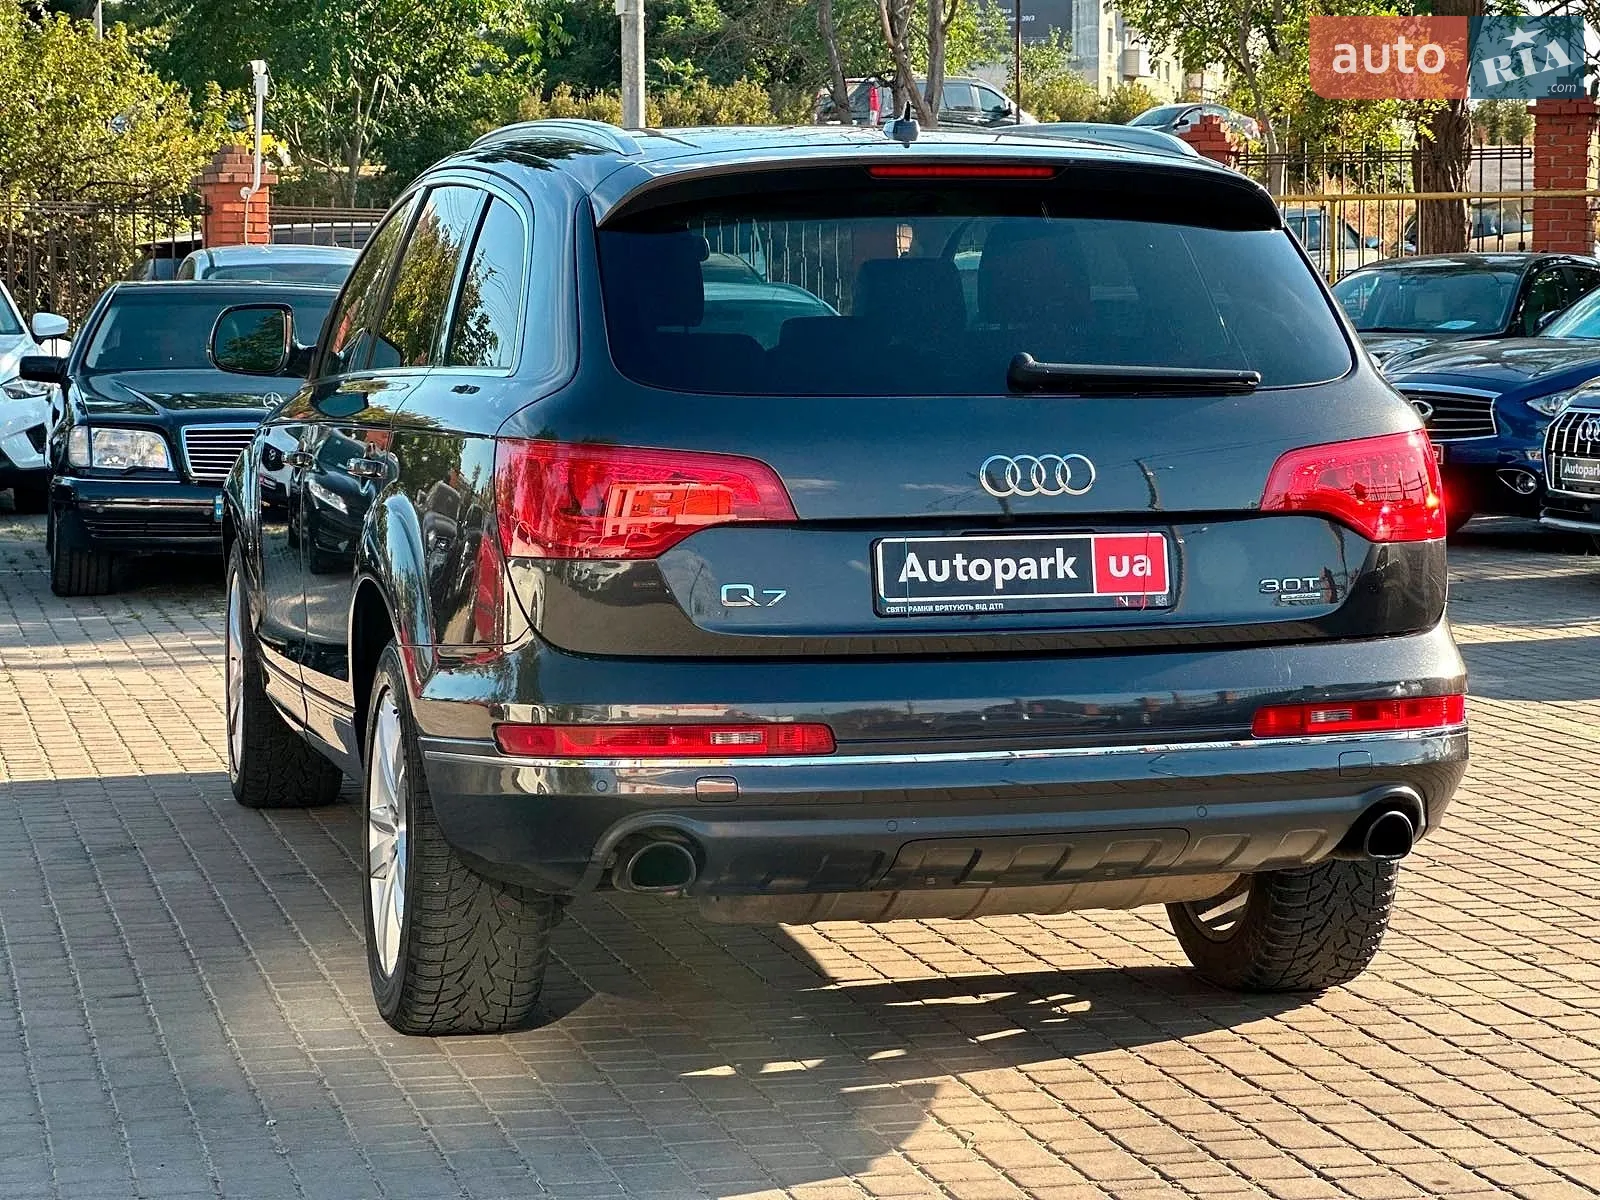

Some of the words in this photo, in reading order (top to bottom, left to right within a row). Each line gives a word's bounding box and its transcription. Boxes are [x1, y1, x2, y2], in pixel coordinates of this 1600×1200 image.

[898, 547, 1078, 590] Autopark
[1108, 553, 1152, 578] ua
[721, 584, 787, 607] Q7
